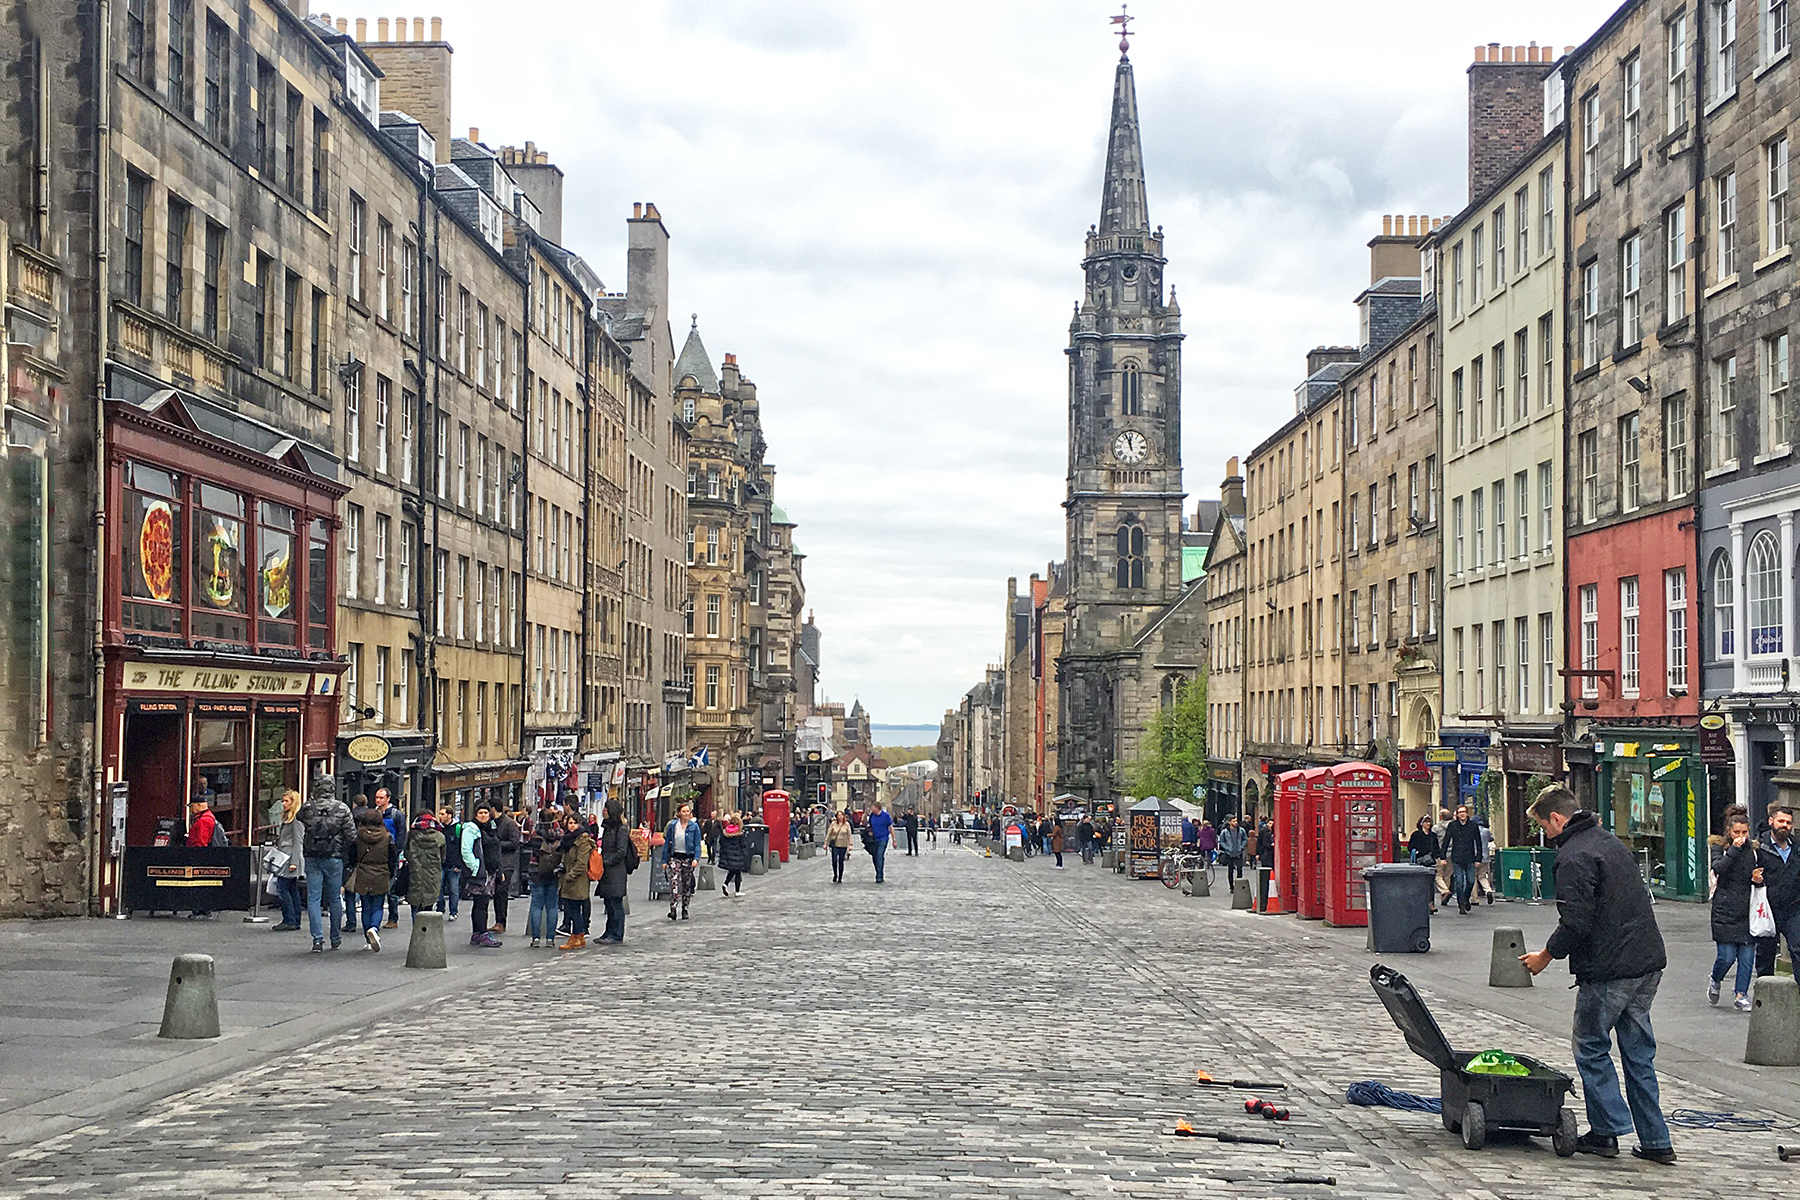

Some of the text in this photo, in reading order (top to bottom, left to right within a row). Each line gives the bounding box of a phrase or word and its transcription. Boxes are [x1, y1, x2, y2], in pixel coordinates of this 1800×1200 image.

[158, 669, 184, 688] THE
[193, 671, 240, 690] FILLING
[246, 674, 288, 691] STATION
[1766, 709, 1800, 722] BAY OF
[352, 737, 385, 748] GORDON'S
[350, 749, 387, 760] TRATTORIA
[1652, 757, 1684, 780] SUBWAY
[1133, 814, 1156, 827] FREE
[1160, 815, 1182, 826] FREE
[1130, 826, 1158, 838] GHOST
[1160, 825, 1182, 835] TOUR
[1686, 777, 1697, 888] SUBWAY
[1132, 837, 1158, 849] TOUR
